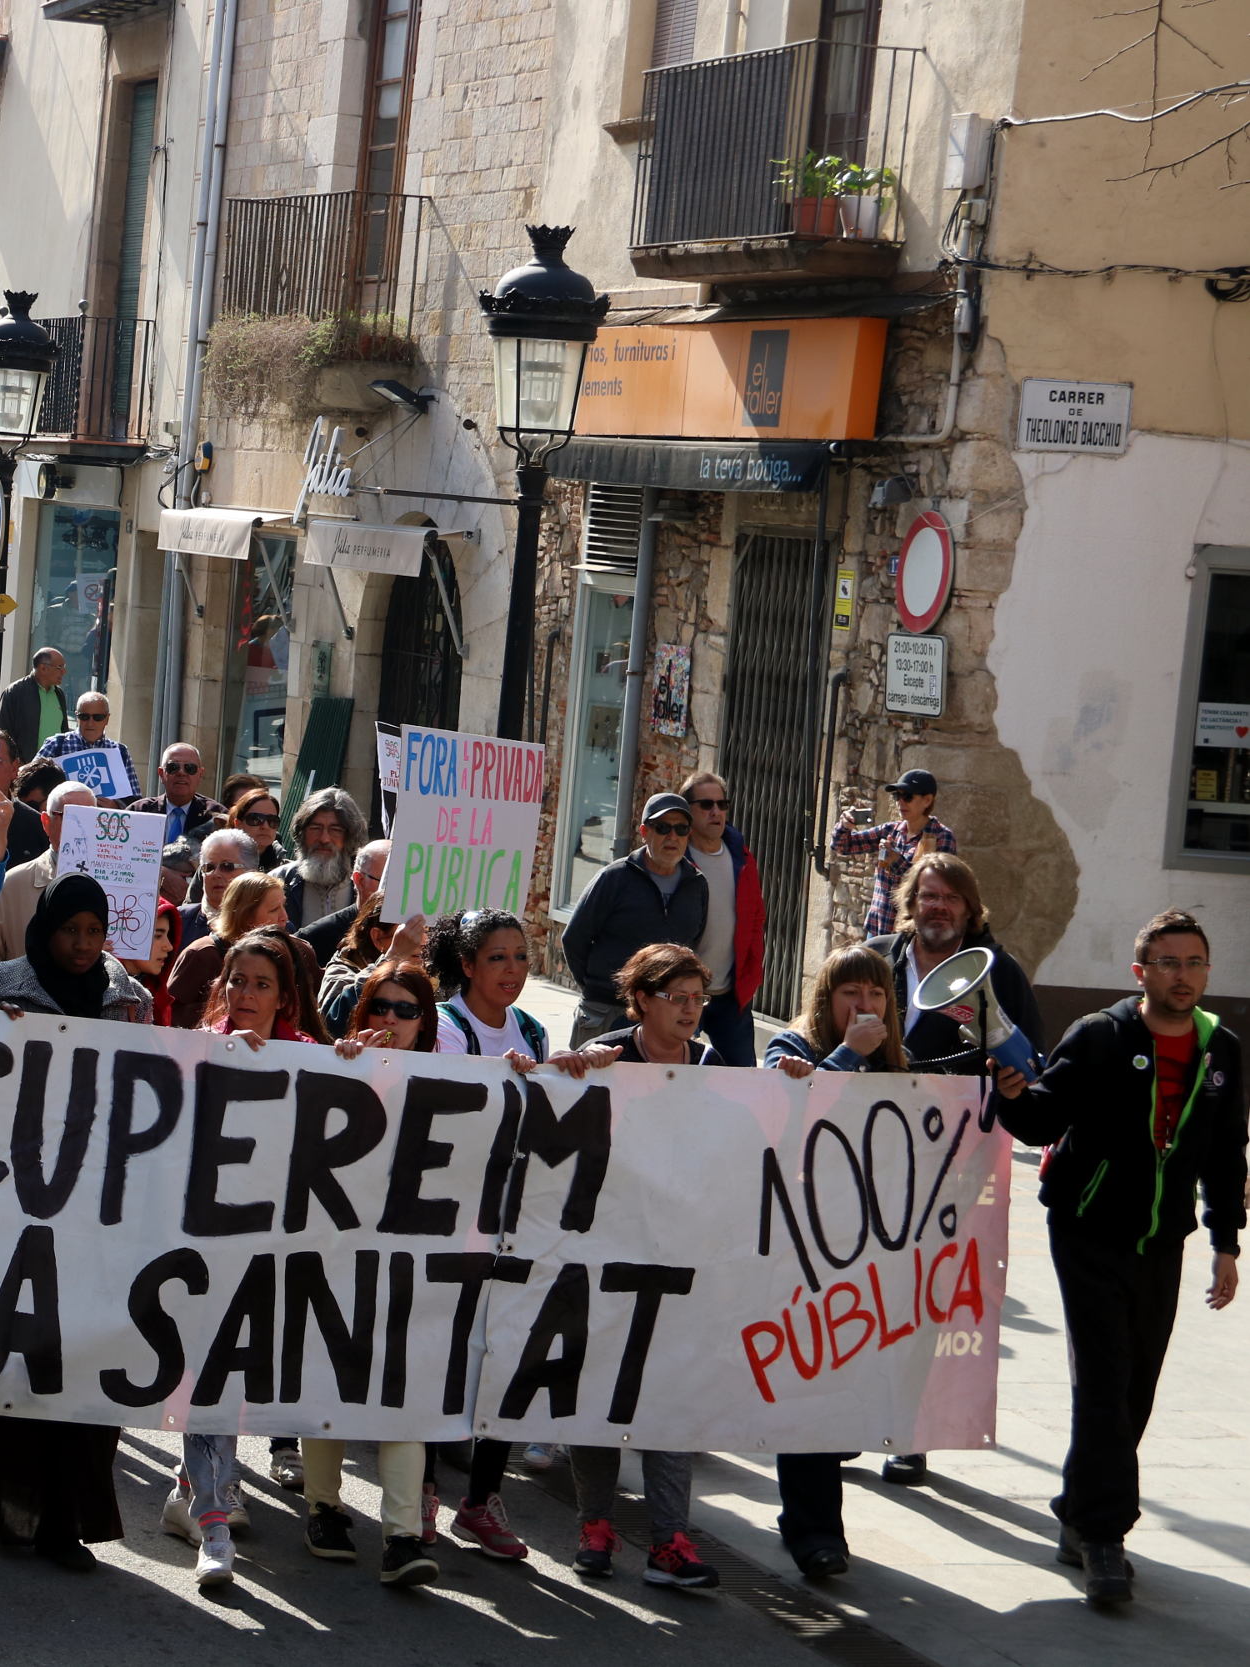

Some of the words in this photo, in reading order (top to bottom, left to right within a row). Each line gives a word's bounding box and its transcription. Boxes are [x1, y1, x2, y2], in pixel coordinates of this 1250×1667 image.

[613, 338, 669, 362] furnituras
[672, 338, 677, 361] i
[752, 343, 771, 386] el
[581, 377, 623, 397] lements
[746, 378, 782, 415] taller
[1048, 390, 1105, 405] CARRER
[1068, 408, 1083, 416] DE
[1025, 418, 1079, 445] THEOLONGO
[1080, 421, 1122, 447] BACCHIO
[700, 452, 711, 480] la
[714, 456, 743, 481] teva
[746, 454, 802, 488] botiga...
[894, 641, 927, 655] 21:00-10:30
[929, 643, 933, 656] h
[658, 659, 673, 695] el
[896, 658, 928, 673] 13:30-17:00
[929, 660, 934, 673] h
[903, 673, 924, 690] Excepte
[405, 732, 457, 797] FORA
[470, 741, 543, 803] PRIVADA
[95, 812, 131, 843] SOS
[436, 806, 462, 844] DE
[469, 807, 493, 845] LA
[758, 1100, 972, 1293] 100%
[99, 1246, 692, 1425] SANITAT
[740, 1237, 984, 1404] PÚBLICA
